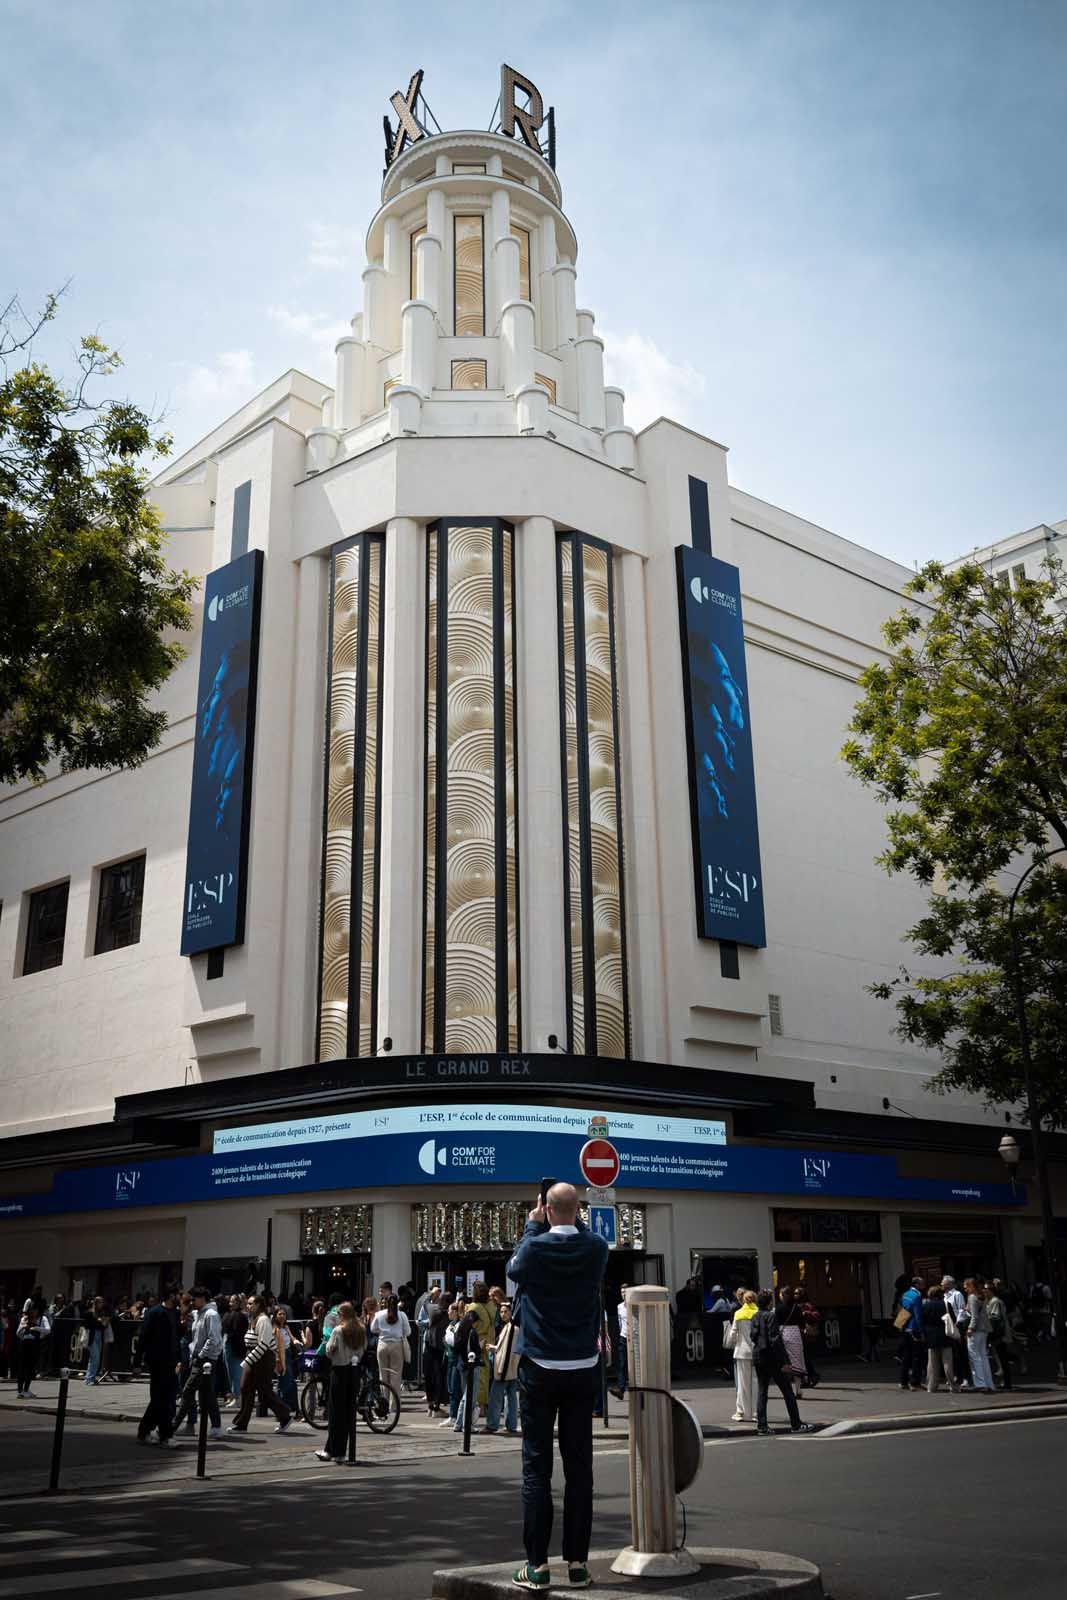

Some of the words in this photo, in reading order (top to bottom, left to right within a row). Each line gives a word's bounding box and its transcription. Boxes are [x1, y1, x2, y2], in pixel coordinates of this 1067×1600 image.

[501, 63, 543, 155] R
[707, 864, 757, 903] ESP
[406, 1061, 426, 1077] LE
[437, 1059, 489, 1075] GRAND
[501, 1060, 530, 1075] REX
[459, 1112, 484, 1121] école
[485, 1112, 497, 1121] de
[498, 1113, 562, 1124] communication
[563, 1115, 586, 1126] depuis
[235, 1134, 242, 1143] de
[243, 1129, 286, 1141] communication
[287, 1127, 306, 1138] depuis
[325, 1122, 351, 1134] présente
[270, 1158, 312, 1169] communication
[452, 1156, 496, 1166] CLIMATE
[630, 1153, 650, 1164] jeunes
[650, 1154, 670, 1164] talents
[670, 1155, 678, 1164] de
[678, 1155, 685, 1165] la
[685, 1157, 728, 1167] communication
[803, 1157, 832, 1177] ESP
[252, 1171, 277, 1181] transition
[278, 1169, 308, 1180] écologique
[630, 1164, 650, 1172] service
[651, 1164, 659, 1172] de
[659, 1164, 665, 1173] la
[665, 1166, 693, 1174] transition
[694, 1168, 724, 1178] écologique
